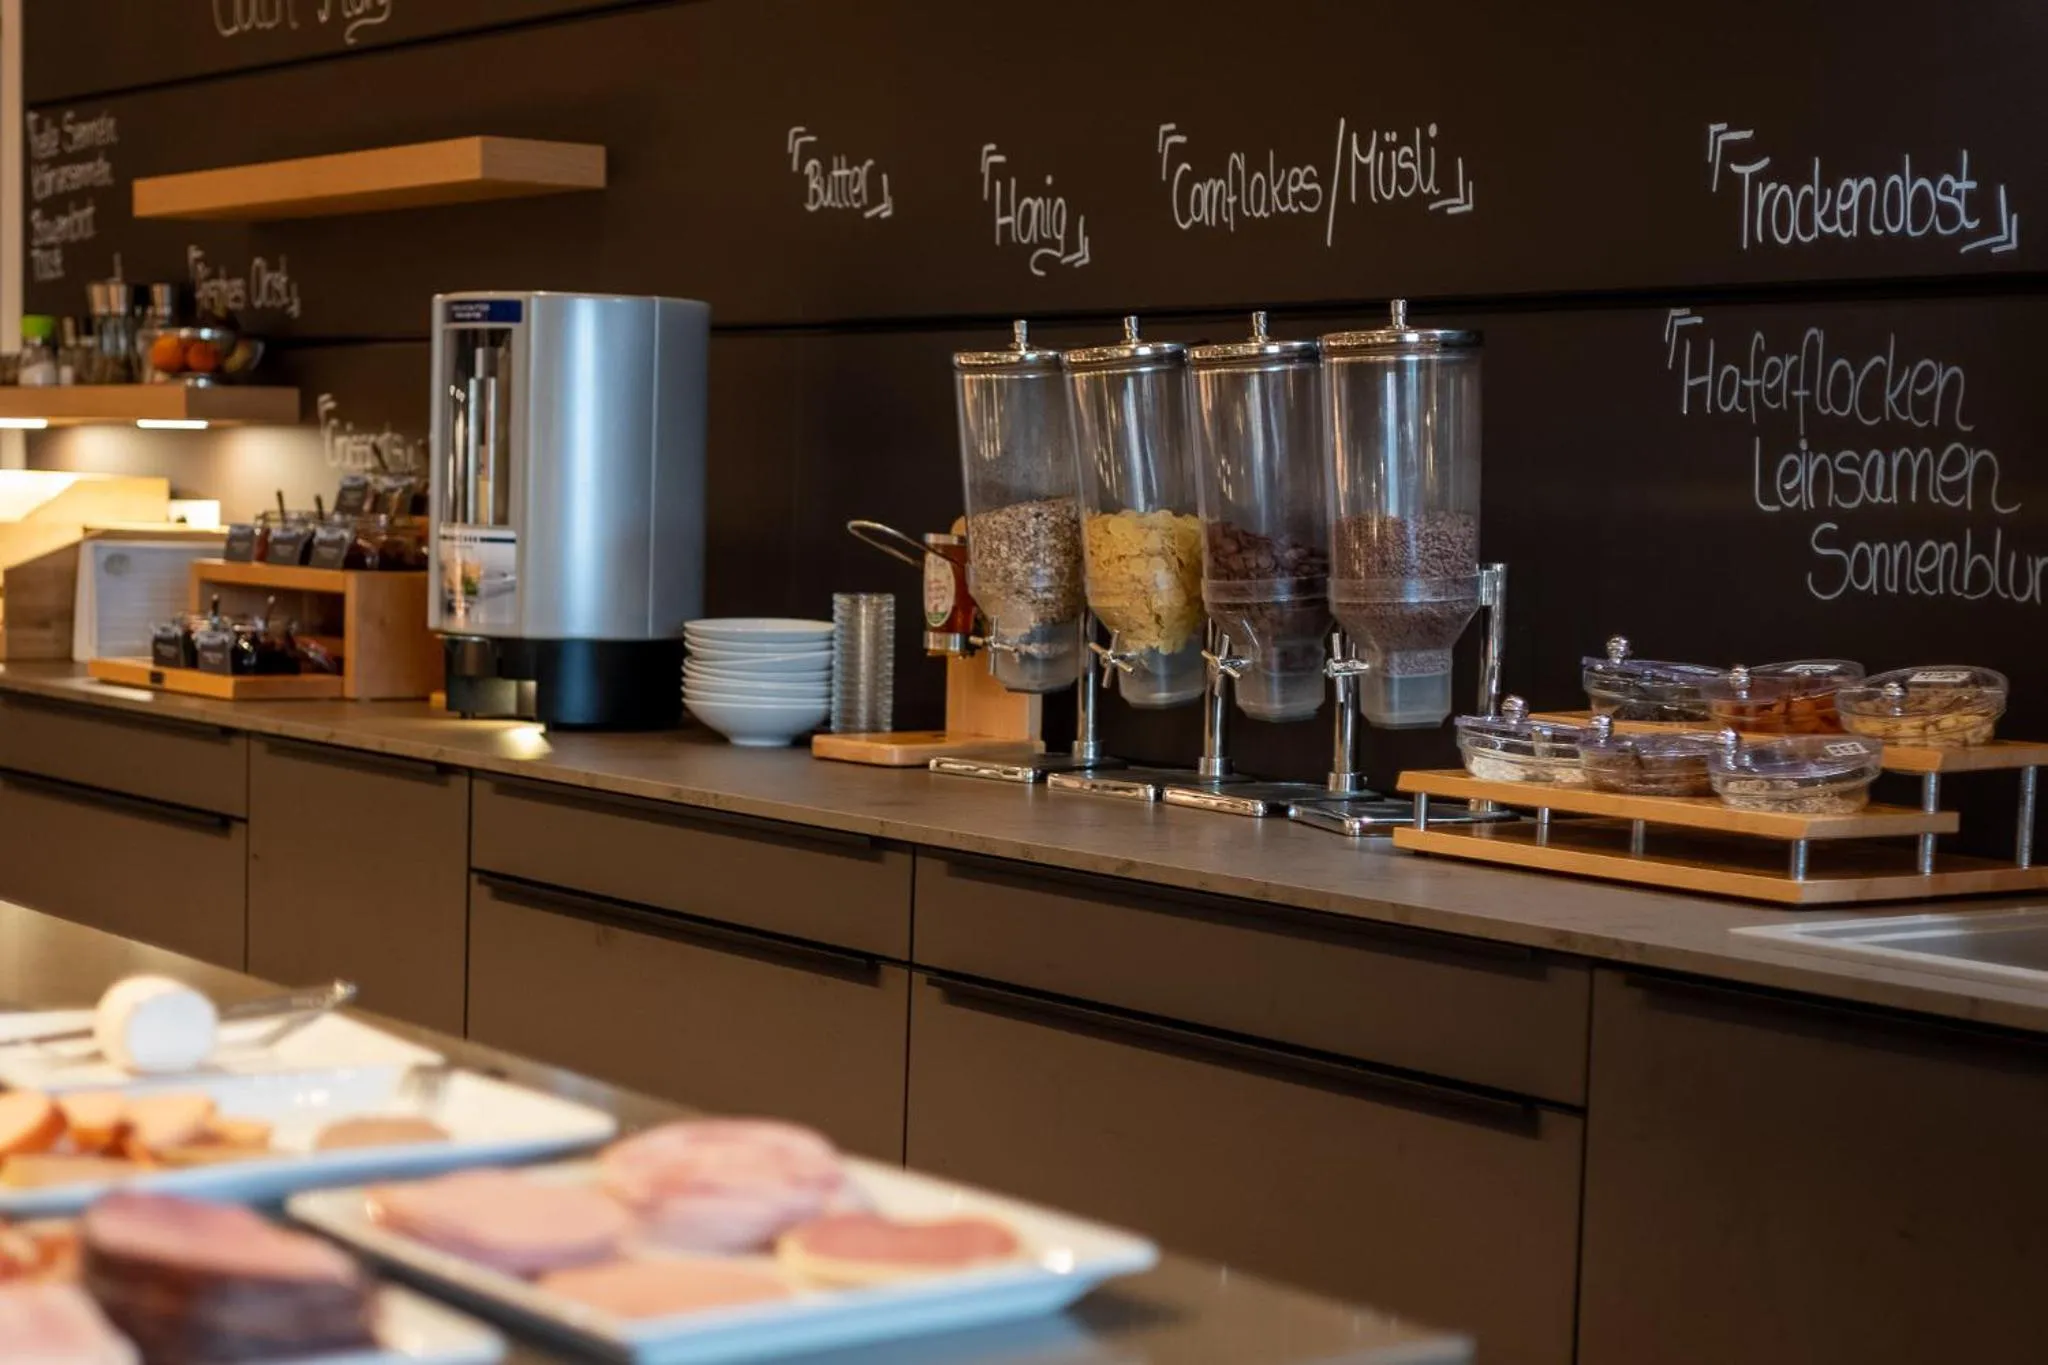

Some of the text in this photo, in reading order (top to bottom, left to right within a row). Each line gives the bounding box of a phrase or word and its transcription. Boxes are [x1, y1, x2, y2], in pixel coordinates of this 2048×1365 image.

[804, 154, 875, 212] Butter
[994, 176, 1067, 276] Honig
[1729, 149, 1980, 251] Trockenobst
[1683, 327, 1975, 436] Haferflocken
[1754, 435, 2021, 514] Leinsamen
